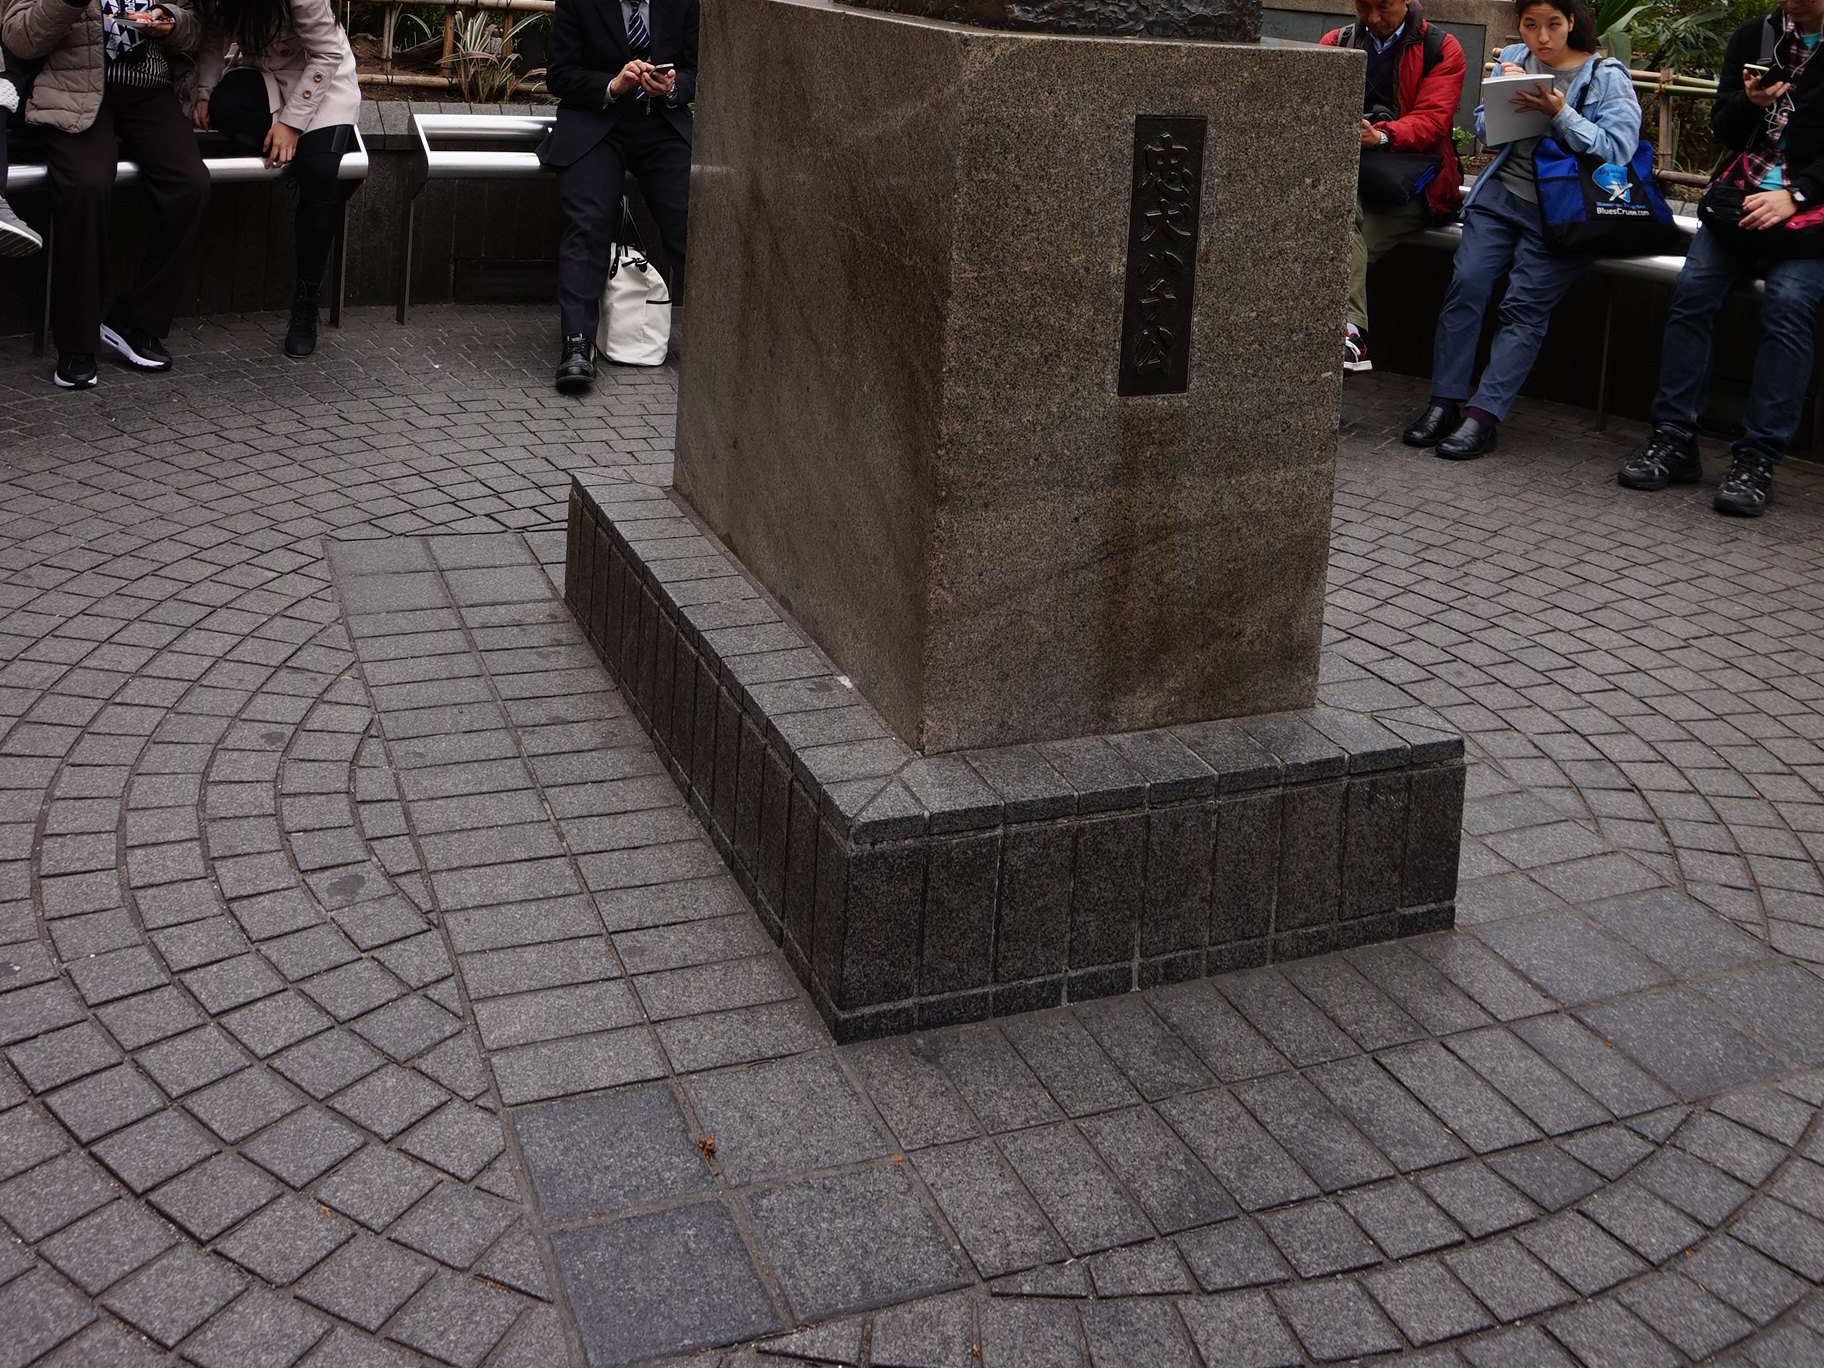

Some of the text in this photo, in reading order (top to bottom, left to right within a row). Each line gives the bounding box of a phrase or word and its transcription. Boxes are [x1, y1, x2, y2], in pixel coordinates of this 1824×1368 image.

[1137, 133, 1194, 377] 忠犬ハチ公
